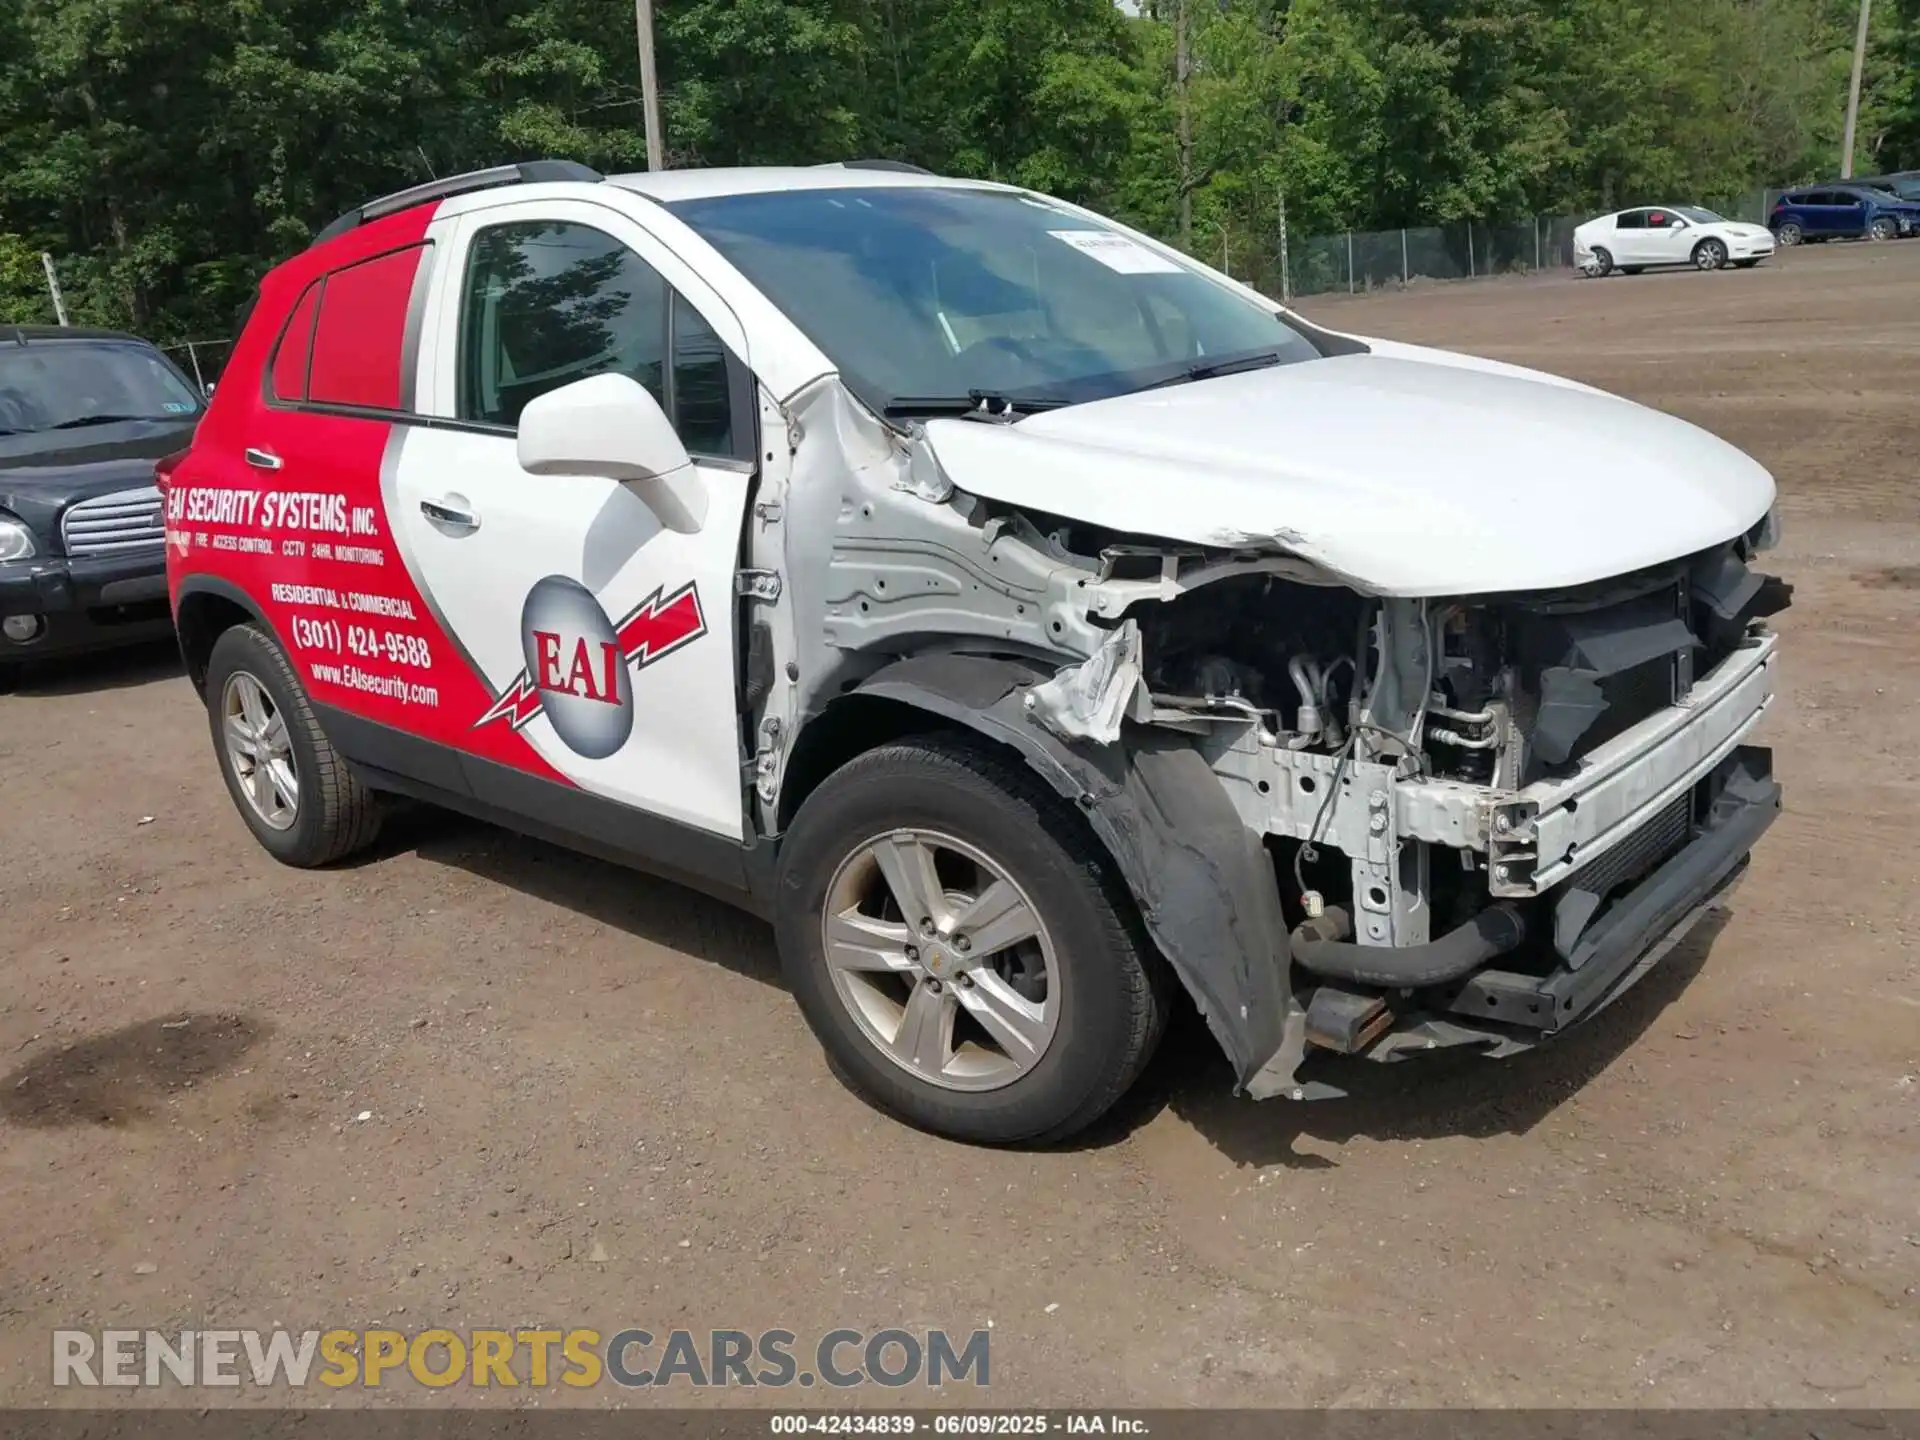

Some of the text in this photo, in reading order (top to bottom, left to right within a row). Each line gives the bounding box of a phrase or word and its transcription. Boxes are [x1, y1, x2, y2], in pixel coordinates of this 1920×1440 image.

[187, 488, 261, 525] SECURITY
[261, 491, 349, 537] SYSTEMS,
[352, 507, 378, 535] INC.
[212, 534, 237, 551] ACCESS
[239, 537, 274, 554] CONTROL
[282, 540, 305, 556] CCTV
[335, 545, 384, 566] MONITORING
[272, 583, 417, 620] RESIDENTIAL & COMMERCIAL
[292, 615, 432, 669] (301) 424-9588
[311, 663, 438, 707] www.EAIsecurity.com
[532, 630, 623, 706] EAI
